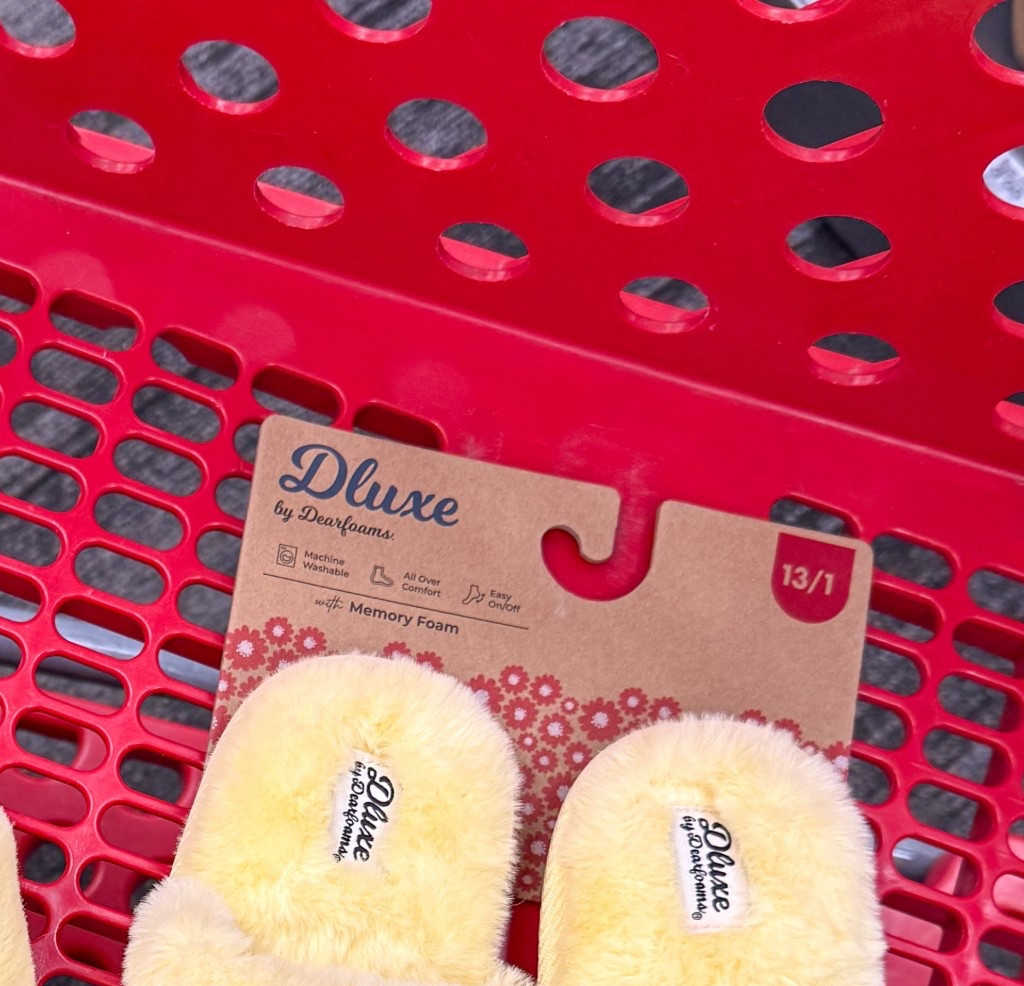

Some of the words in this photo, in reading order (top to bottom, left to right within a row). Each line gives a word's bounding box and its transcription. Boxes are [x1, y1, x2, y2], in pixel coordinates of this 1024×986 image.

[278, 443, 459, 527] Dluxe
[273, 499, 294, 522] by
[303, 550, 346, 567] Machine
[302, 560, 350, 579] Washable
[403, 571, 417, 583] All
[418, 574, 441, 587] Over
[782, 564, 835, 596] 13/1
[401, 582, 442, 598] Comfort
[489, 589, 513, 602] Easy
[314, 594, 344, 613] with
[349, 601, 413, 628] Memory
[416, 615, 459, 635] Foam
[487, 599, 522, 615] On/Off
[349, 760, 367, 777] by
[352, 766, 395, 862] Dluxe
[679, 815, 697, 831] by
[697, 817, 736, 913] Dluxe
